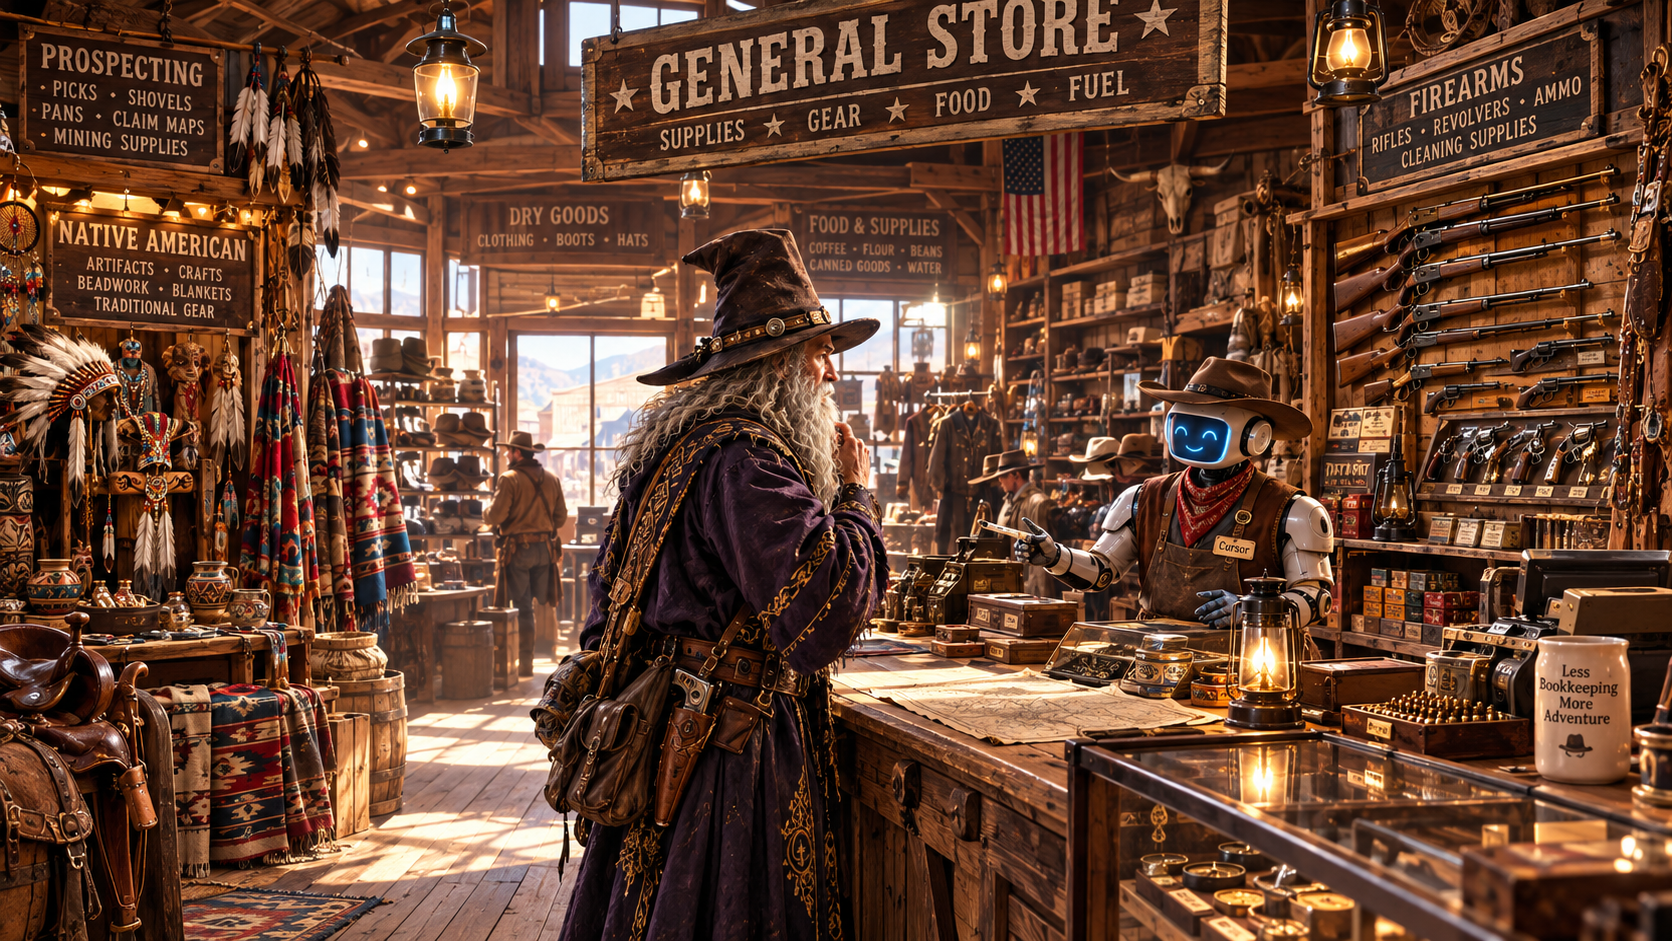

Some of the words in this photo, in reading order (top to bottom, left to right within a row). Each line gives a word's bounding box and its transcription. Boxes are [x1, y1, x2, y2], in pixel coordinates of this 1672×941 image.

[41, 43, 203, 86] PROSPECTING
[650, 14, 901, 114] GENERAL
[927, 0, 1118, 69] STORE
[54, 80, 97, 100] PICKS
[129, 89, 191, 111] SHOVELS
[1410, 56, 1523, 118] FIREARMS
[42, 103, 83, 122] PANS
[113, 111, 158, 130] CLAIM
[167, 116, 204, 135] MAPS
[660, 119, 744, 150] SUPPLIES
[808, 104, 861, 132] GEAR
[936, 87, 990, 117] FOOD
[1069, 70, 1129, 101] FUEL
[1372, 127, 1411, 153] RIFLES
[1434, 97, 1509, 136] REVOLVERS
[1534, 76, 1581, 106] AMMO
[54, 128, 111, 149] MINING
[121, 134, 187, 156] SUPPLIES
[1402, 136, 1462, 168] CLEANING
[1471, 115, 1536, 149] SUPPLIES
[510, 207, 543, 226] DRY
[550, 206, 609, 224] GOODS
[809, 215, 849, 234] FOOD
[854, 217, 865, 234] &
[870, 217, 939, 236] SUPPLIES
[59, 220, 138, 250] NATIVE
[146, 229, 246, 261] AMERICAN
[477, 233, 534, 248] CLOTHING
[557, 233, 594, 246] BOOTS
[618, 233, 648, 247] HATS
[809, 242, 846, 255] COFFEE
[863, 243, 894, 256] FLOUR
[911, 245, 942, 258] BEANS
[87, 257, 154, 275] ARTIFACTS
[179, 265, 222, 281] CRAFTS
[809, 259, 853, 272] CANNED
[857, 260, 890, 272] GOODS
[908, 260, 942, 274] WATER
[78, 275, 149, 294] BEADWORK
[173, 284, 231, 301] BLANKETS
[94, 297, 177, 316] TRADITIONAL
[184, 303, 214, 318] GEAR
[1219, 541, 1250, 554] Cursor
[1562, 664, 1590, 678] Less
[1540, 677, 1618, 697] Bookkeeping
[1559, 696, 1593, 710] More
[1544, 709, 1610, 725] Adventure
